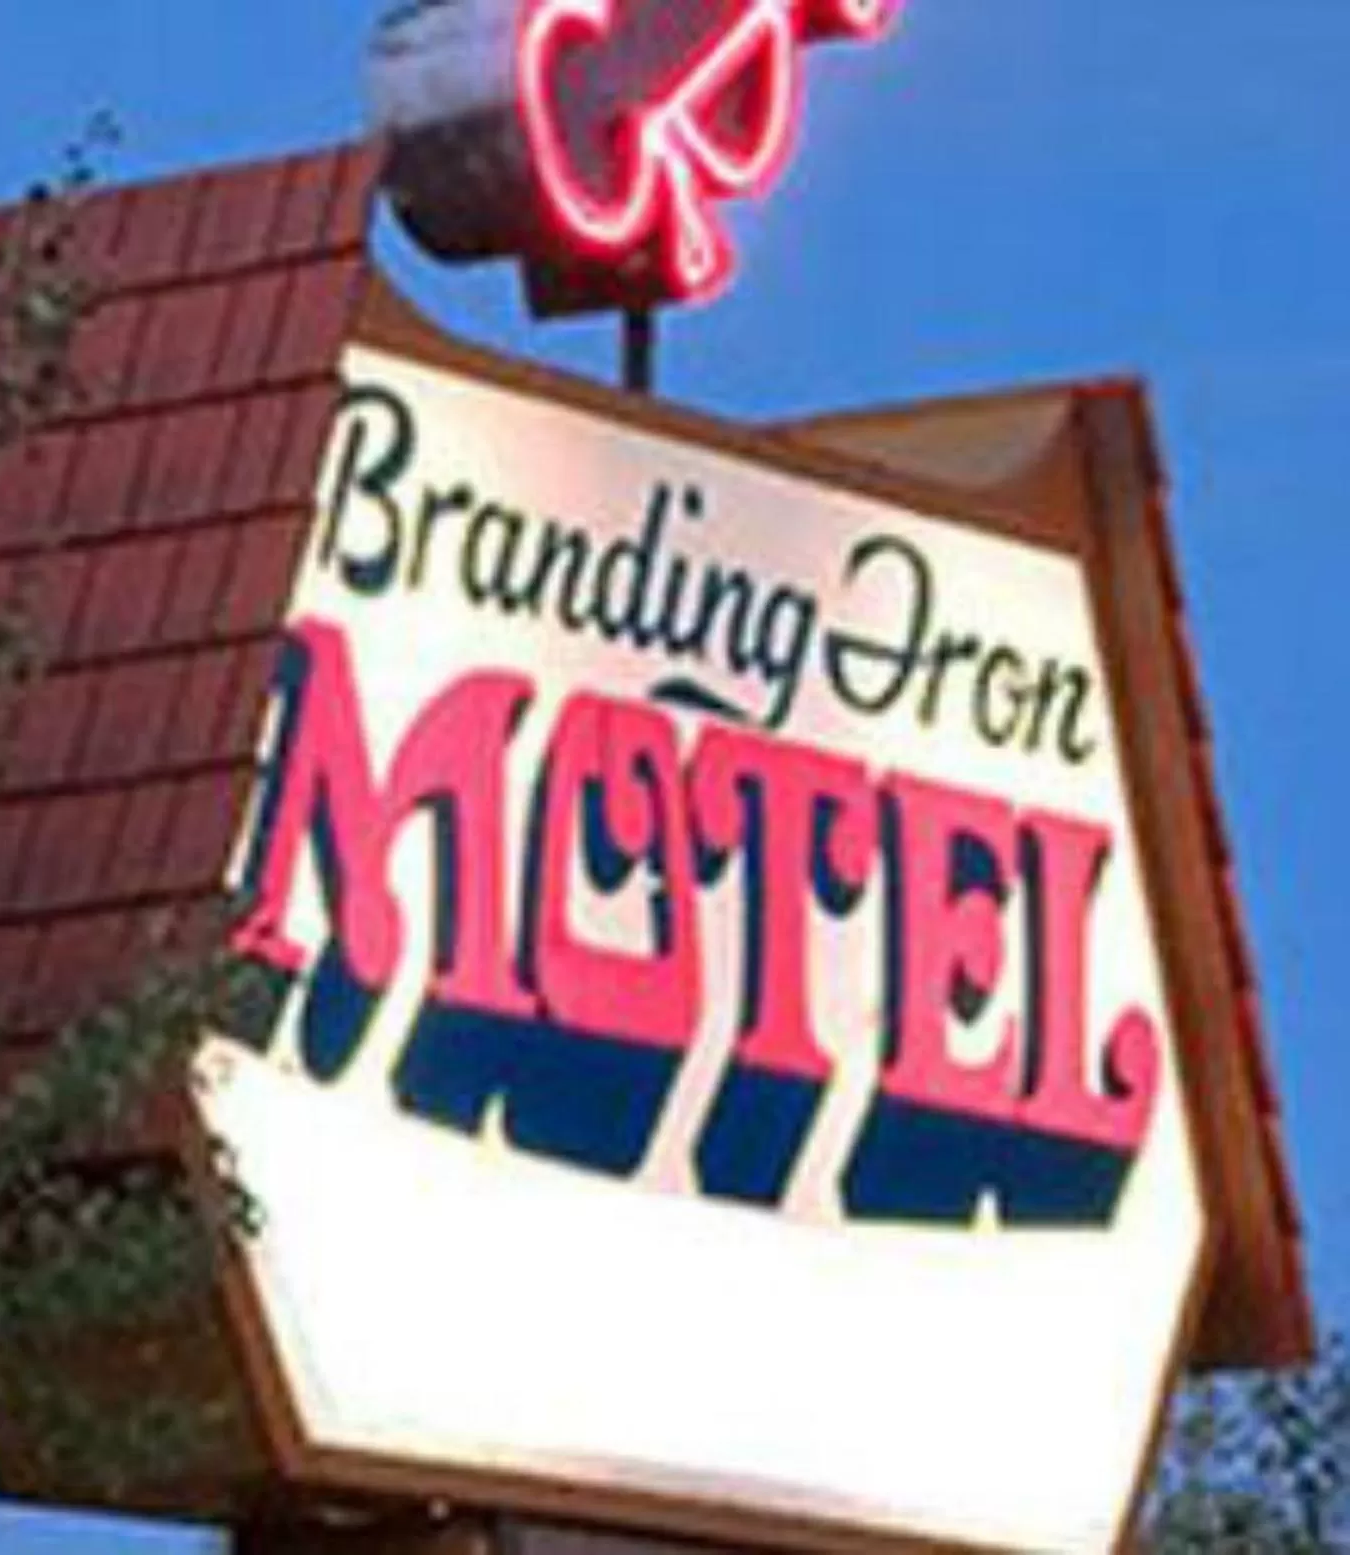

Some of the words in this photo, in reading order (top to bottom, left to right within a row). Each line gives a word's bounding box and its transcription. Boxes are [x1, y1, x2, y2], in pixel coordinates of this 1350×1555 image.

[319, 384, 818, 730] Branding
[824, 534, 1097, 763] Iron
[228, 615, 1163, 1160] MOTEL
